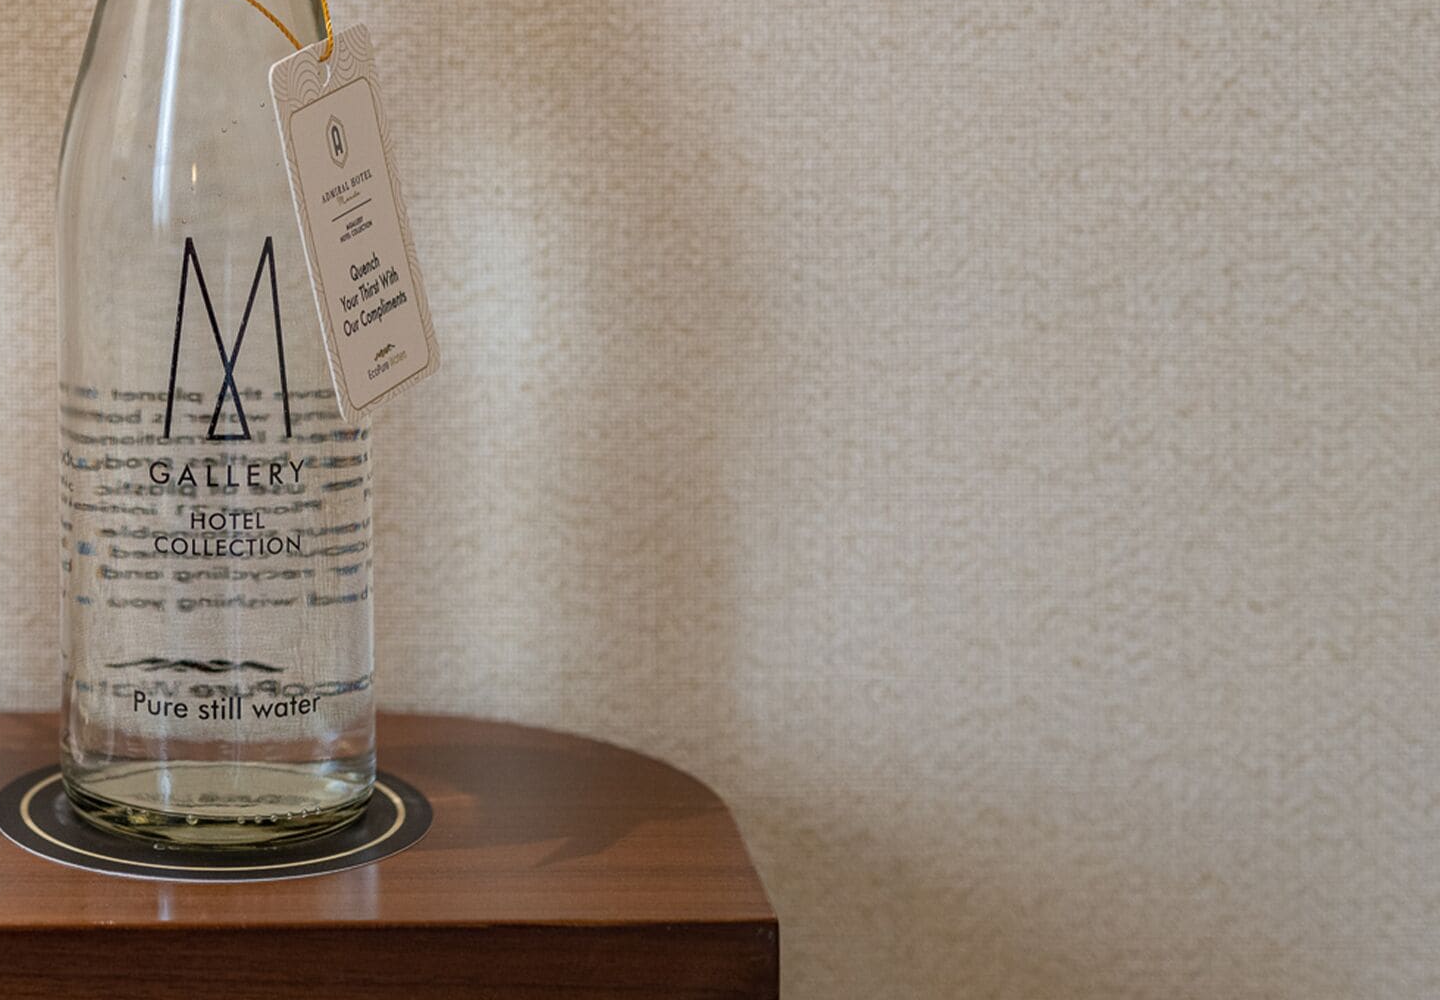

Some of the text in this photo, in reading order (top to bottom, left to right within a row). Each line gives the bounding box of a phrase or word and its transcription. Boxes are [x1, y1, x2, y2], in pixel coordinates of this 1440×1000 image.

[350, 251, 380, 281] Quench
[339, 266, 399, 312] Your Thirst With
[343, 291, 407, 337] Our Compliments
[149, 459, 305, 487] GALLERY
[191, 512, 265, 530] HOTEL
[154, 534, 301, 556] COLLECTION
[133, 690, 321, 720] Pure still water
